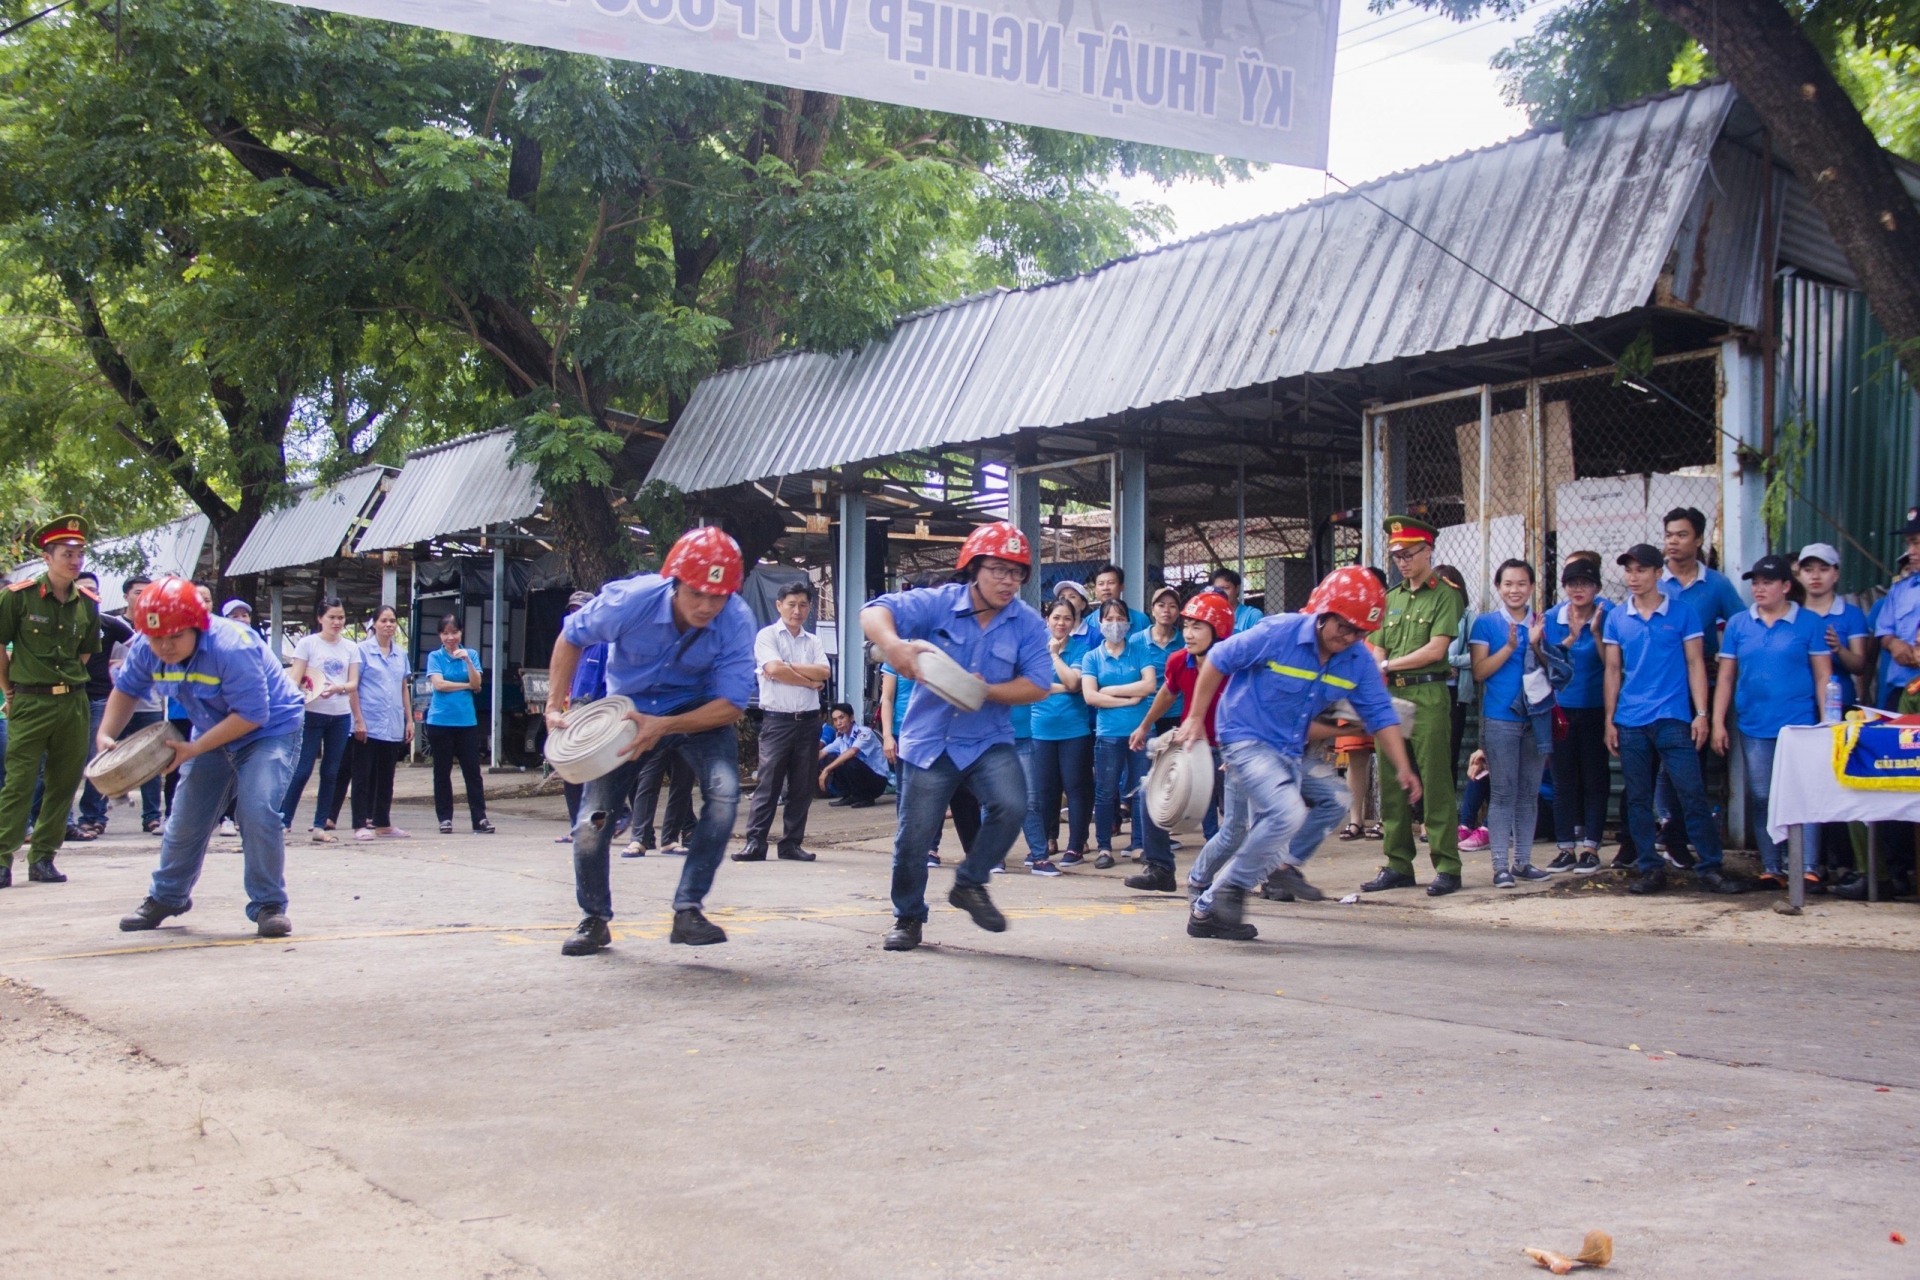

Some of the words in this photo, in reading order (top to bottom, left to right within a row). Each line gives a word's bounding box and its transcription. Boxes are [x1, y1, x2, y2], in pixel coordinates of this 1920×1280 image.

[1011, 539, 1020, 551] 3
[710, 568, 720, 580] 4
[1370, 608, 1380, 620] 2
